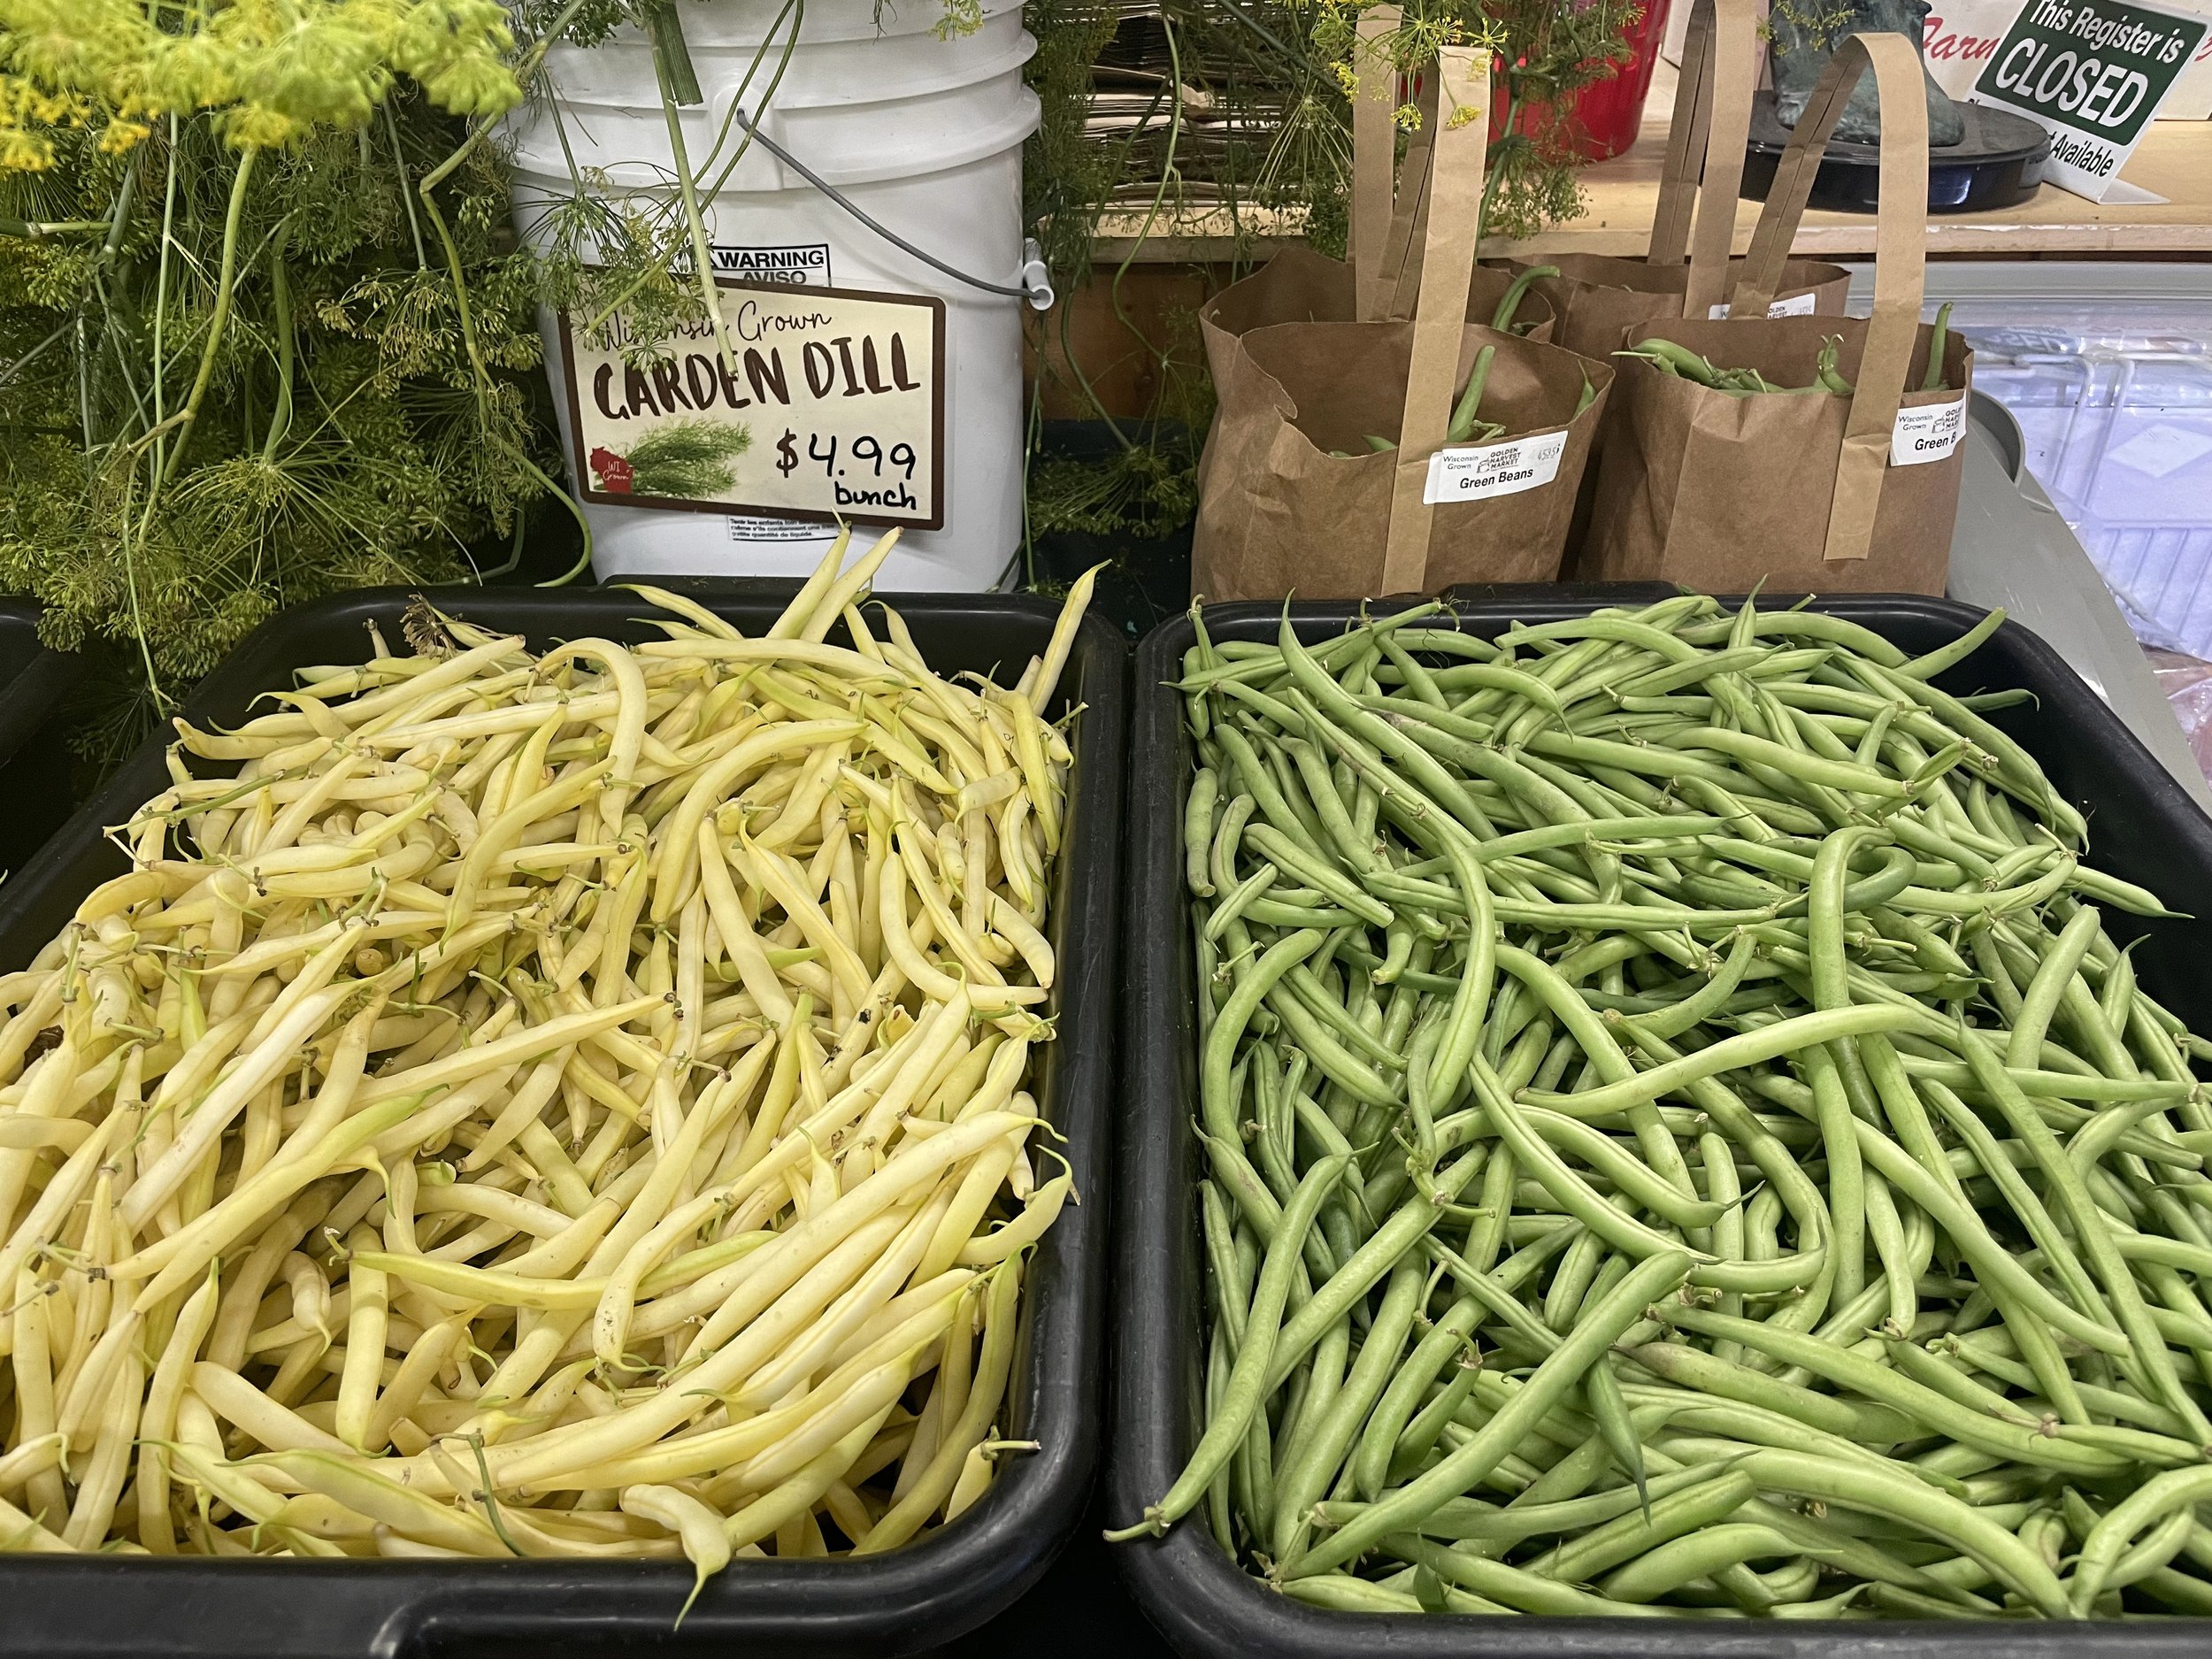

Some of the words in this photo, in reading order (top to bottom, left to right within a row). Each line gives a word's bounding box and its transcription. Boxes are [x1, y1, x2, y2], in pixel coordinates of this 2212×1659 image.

[2030, 0, 2073, 31] This
[2069, 7, 2163, 57] Register
[2156, 28, 2185, 64] is
[1995, 38, 2148, 127] CLOSED
[2049, 134, 2114, 177] Available
[718, 250, 824, 268] WARNING
[742, 271, 807, 284] AVISO
[738, 300, 832, 342] Grown
[594, 347, 790, 420] GARDEN
[803, 332, 921, 399] DILL
[1898, 414, 1933, 423] Wisconsin
[776, 427, 916, 480] $4.99
[1490, 447, 1519, 458] GOLDEN
[1915, 438, 1948, 451] Green
[608, 461, 620, 472] WI
[1490, 452, 1522, 465] HARVEST
[1490, 458, 1519, 470] MARKET
[1460, 477, 1494, 489] Green
[1498, 468, 1534, 483] Beans
[835, 480, 917, 511] bunch
